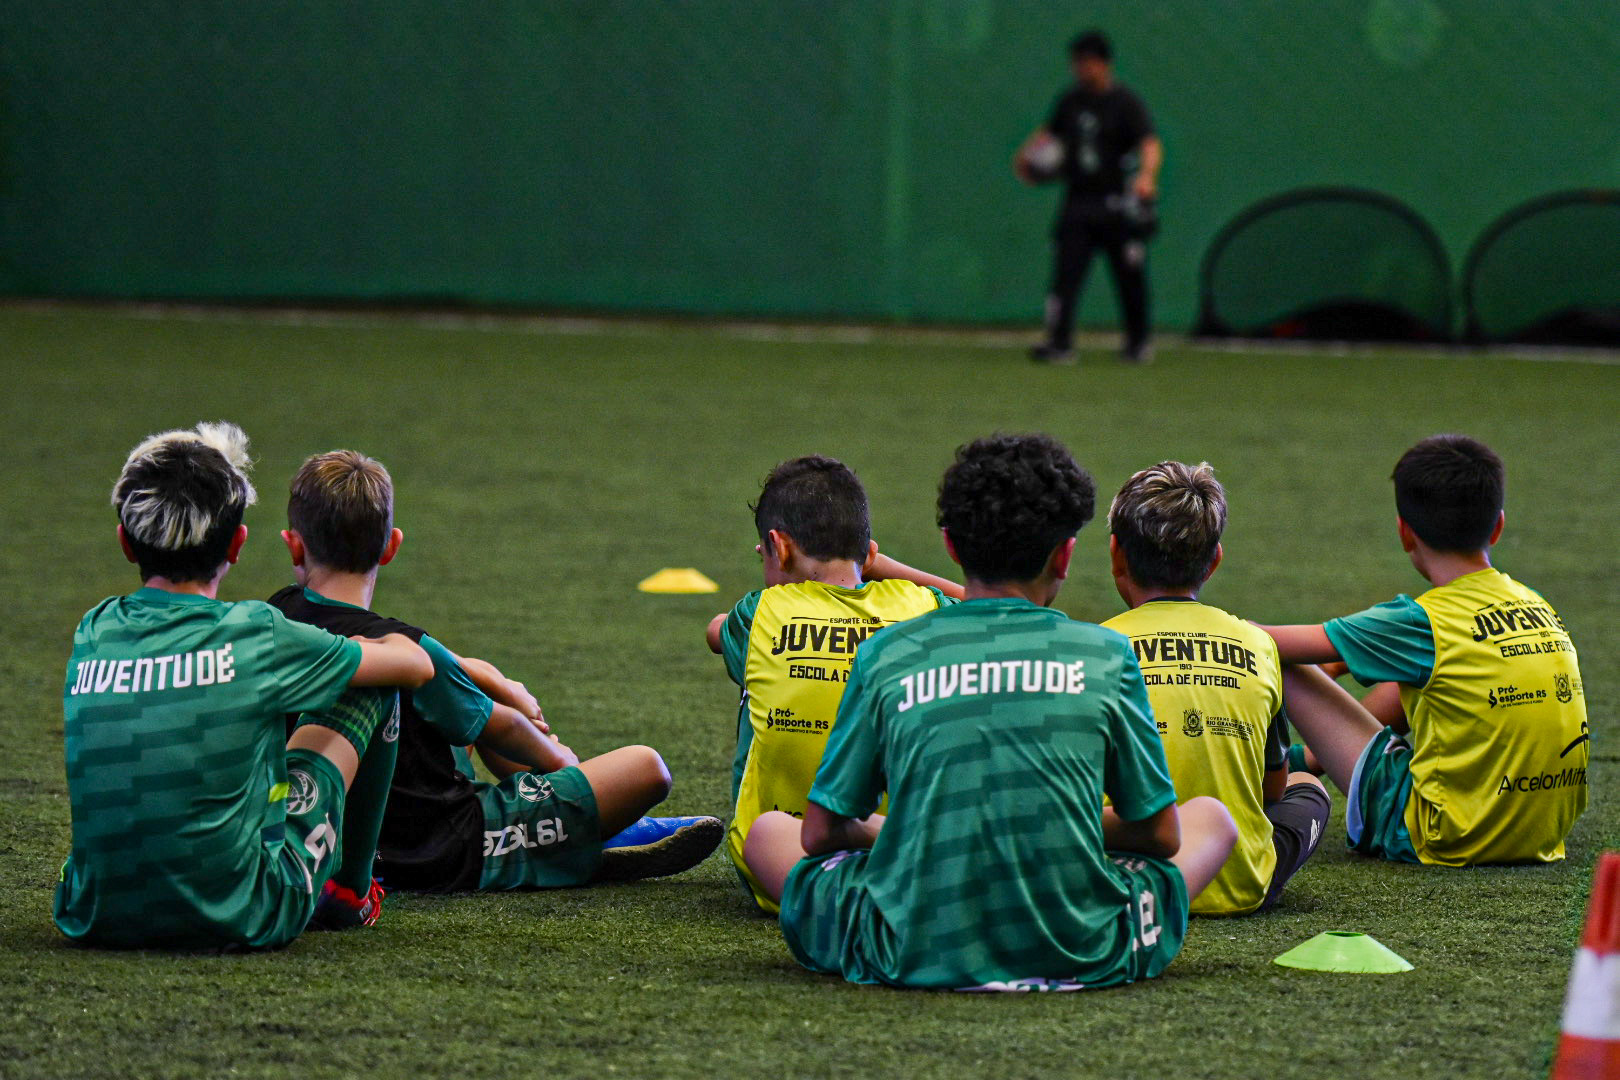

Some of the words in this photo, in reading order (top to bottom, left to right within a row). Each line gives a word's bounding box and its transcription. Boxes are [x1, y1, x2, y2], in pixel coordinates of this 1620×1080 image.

[829, 617, 860, 625] ESPORTE
[1500, 643, 1542, 658] ESCOLA
[1541, 641, 1556, 654] DE
[1179, 663, 1193, 671] 1913
[789, 665, 840, 683] ESCOLA
[1176, 674, 1191, 686] DE
[1193, 674, 1241, 690] FUTEBOL
[1498, 685, 1518, 695] Pró-
[1499, 691, 1534, 704] esporte
[1536, 689, 1547, 698] RS
[775, 708, 795, 718] Pró-
[775, 718, 813, 730] esporte
[815, 720, 829, 730] RS
[1156, 721, 1168, 729] RS
